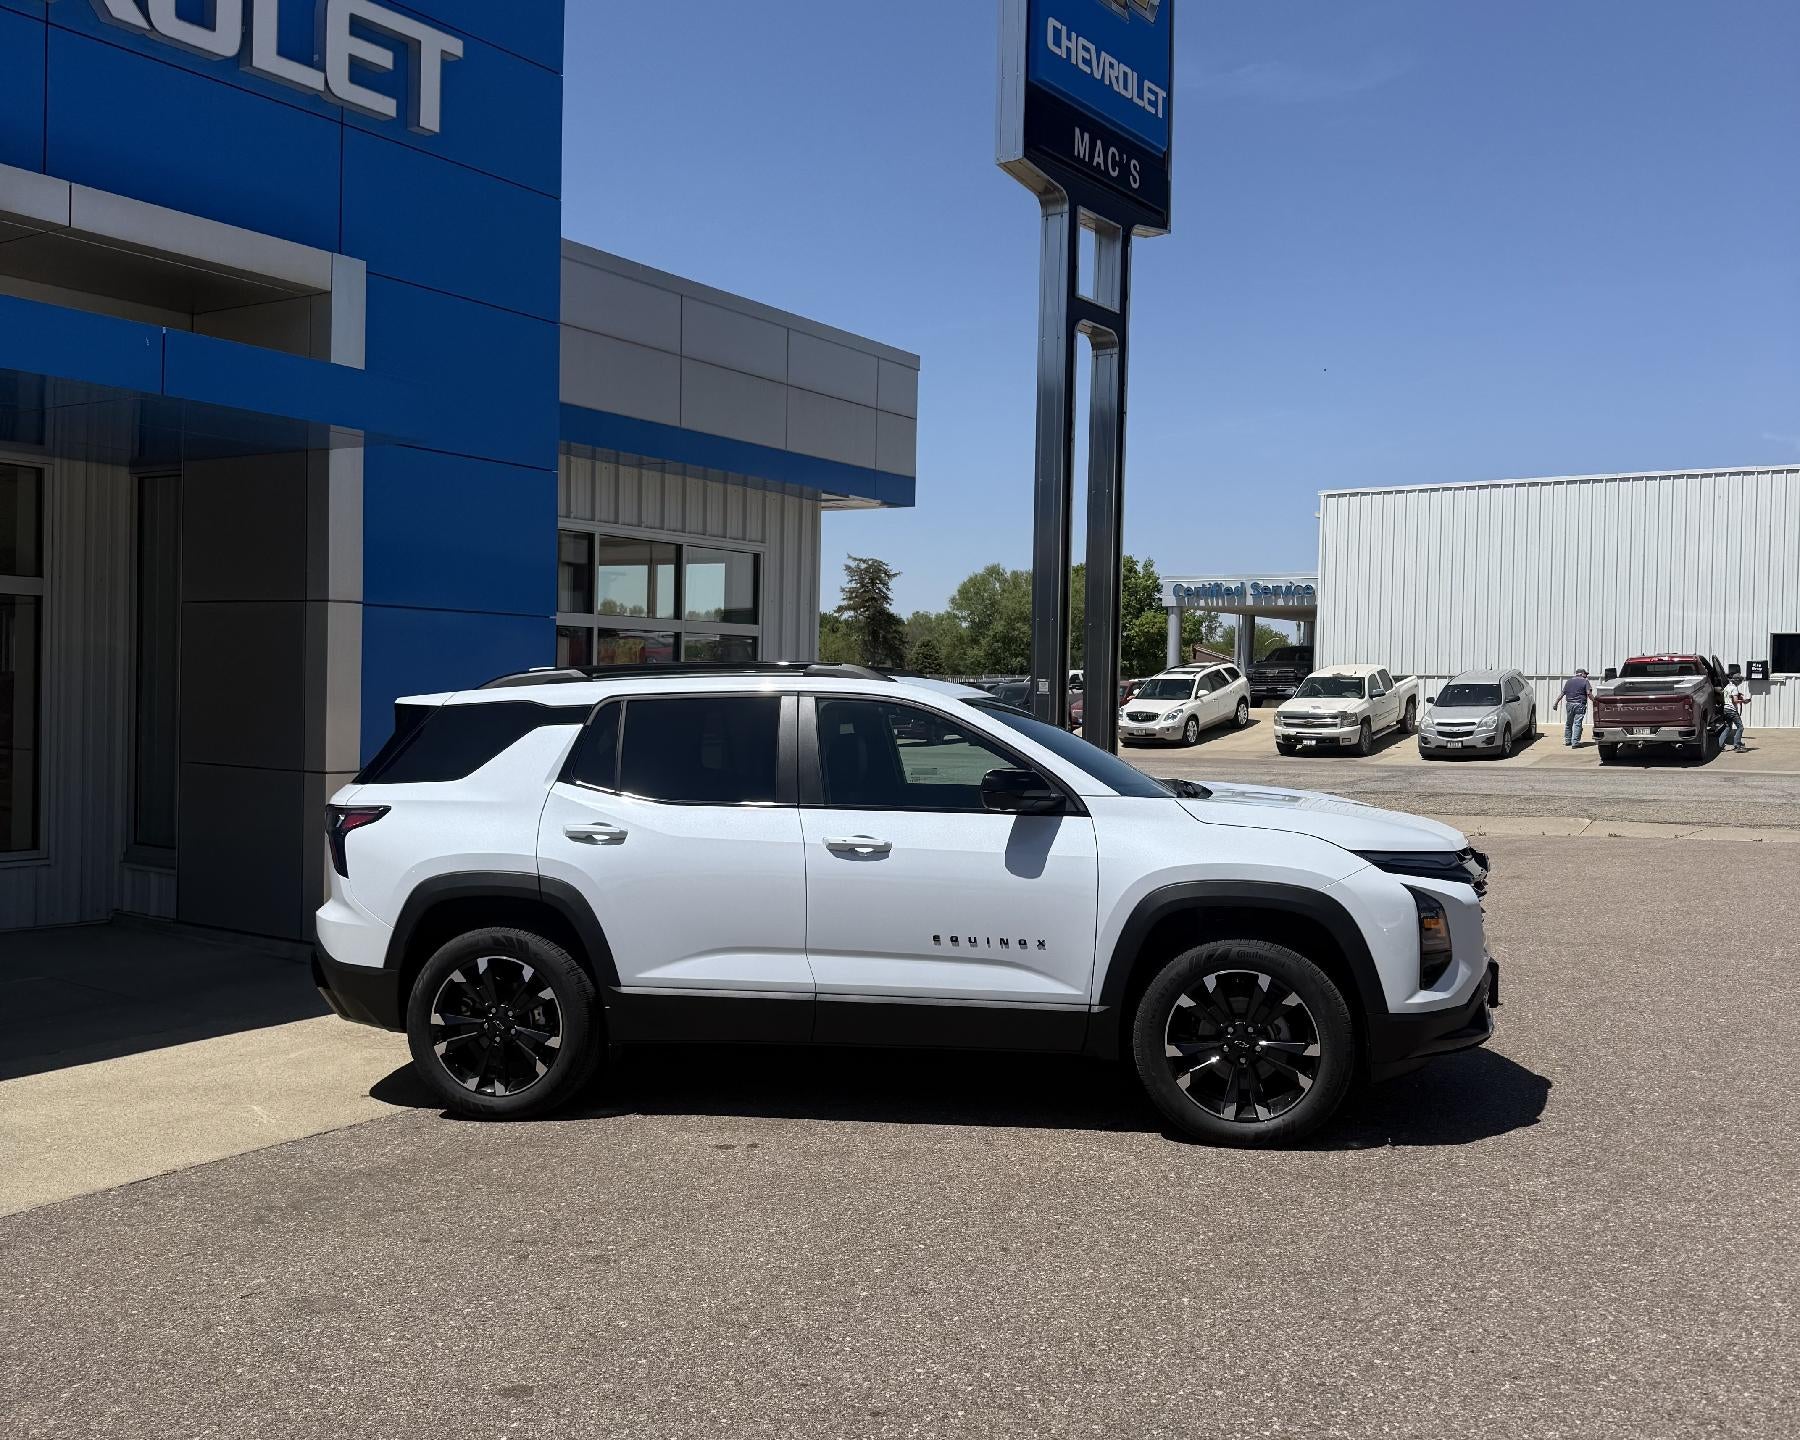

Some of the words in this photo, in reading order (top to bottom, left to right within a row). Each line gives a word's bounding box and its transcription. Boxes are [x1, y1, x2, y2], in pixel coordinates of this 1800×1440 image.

[96, 0, 464, 134] LET
[1046, 16, 1167, 119] CHEVROLET
[1073, 126, 1140, 189] MAC'S
[1172, 582, 1246, 598] Certified
[1250, 581, 1315, 597] Service
[932, 934, 1046, 949] EQUINOX
